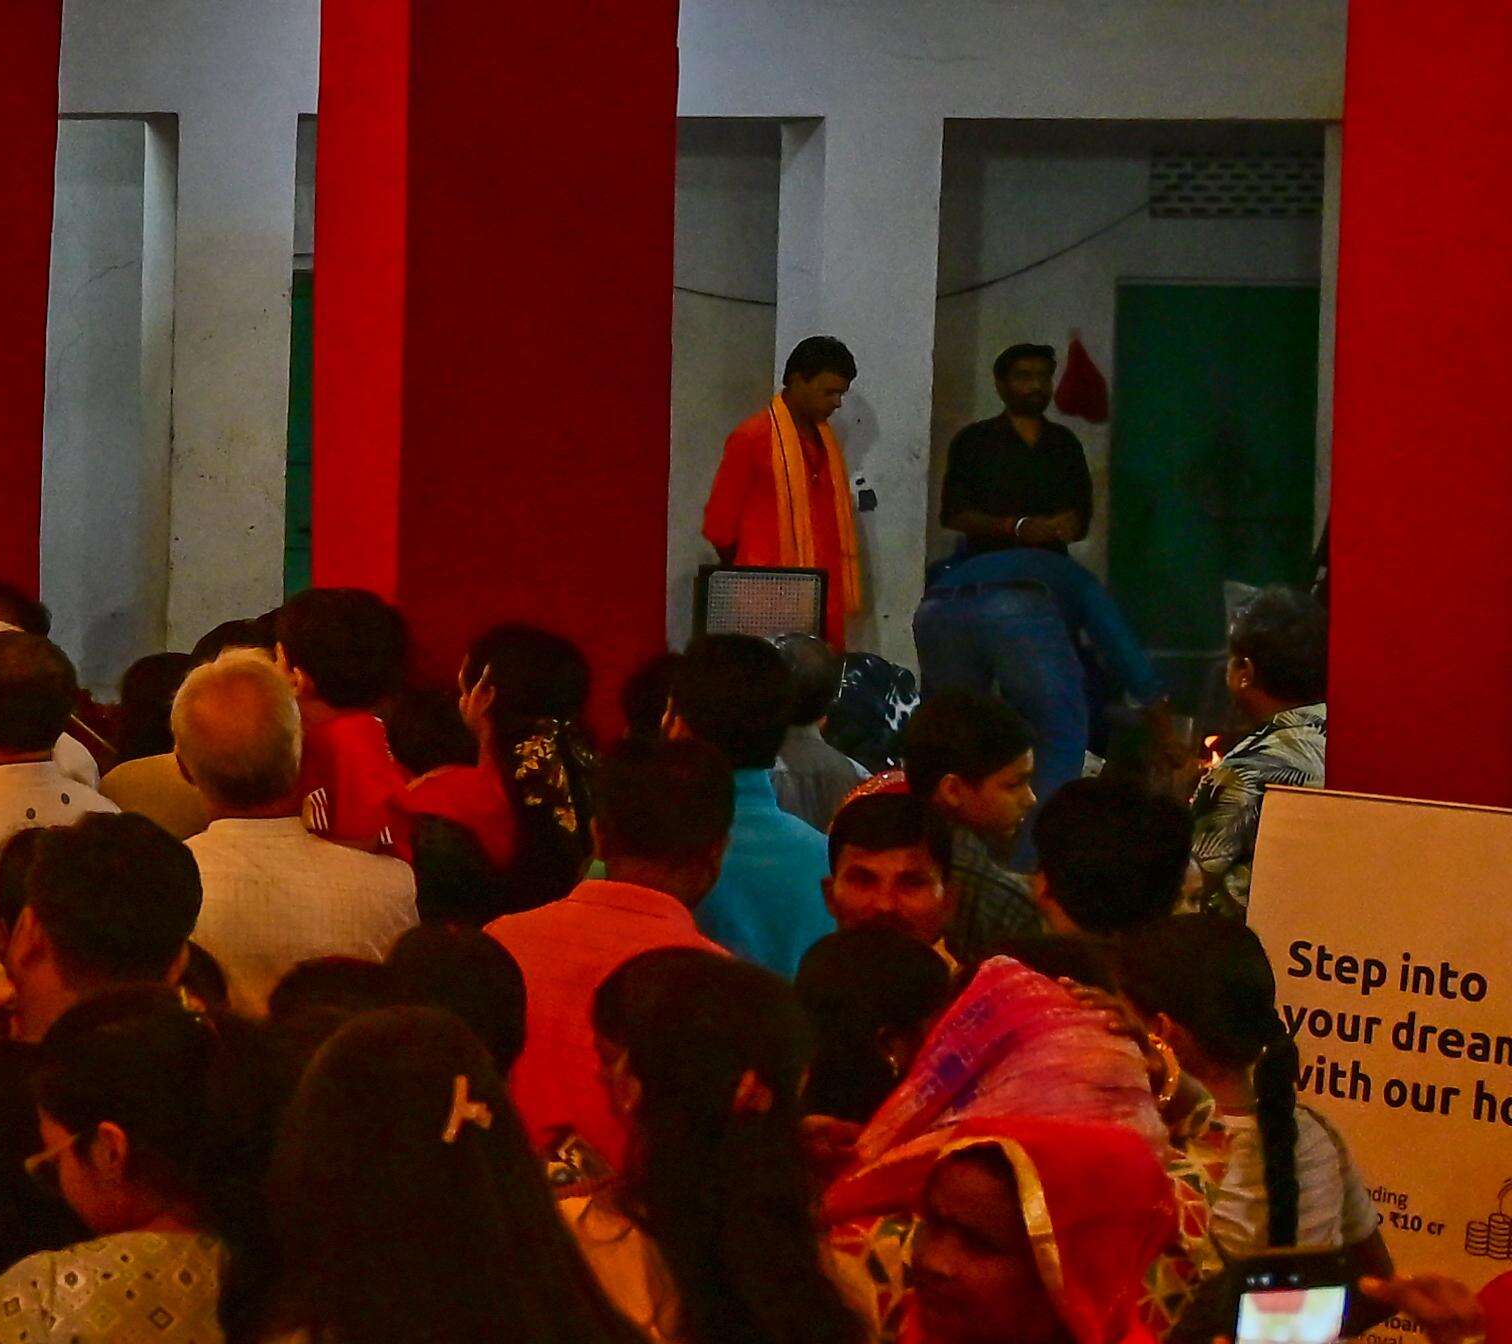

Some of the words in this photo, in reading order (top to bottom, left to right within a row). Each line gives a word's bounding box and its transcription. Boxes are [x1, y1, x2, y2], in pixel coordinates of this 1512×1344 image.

[1287, 939, 1387, 996] Step
[1399, 952, 1488, 1002] into
[1282, 1004, 1382, 1045] your
[1384, 1078, 1461, 1115] our
[1390, 1211, 1422, 1233] ₹10
[1426, 1220, 1445, 1237] cr
